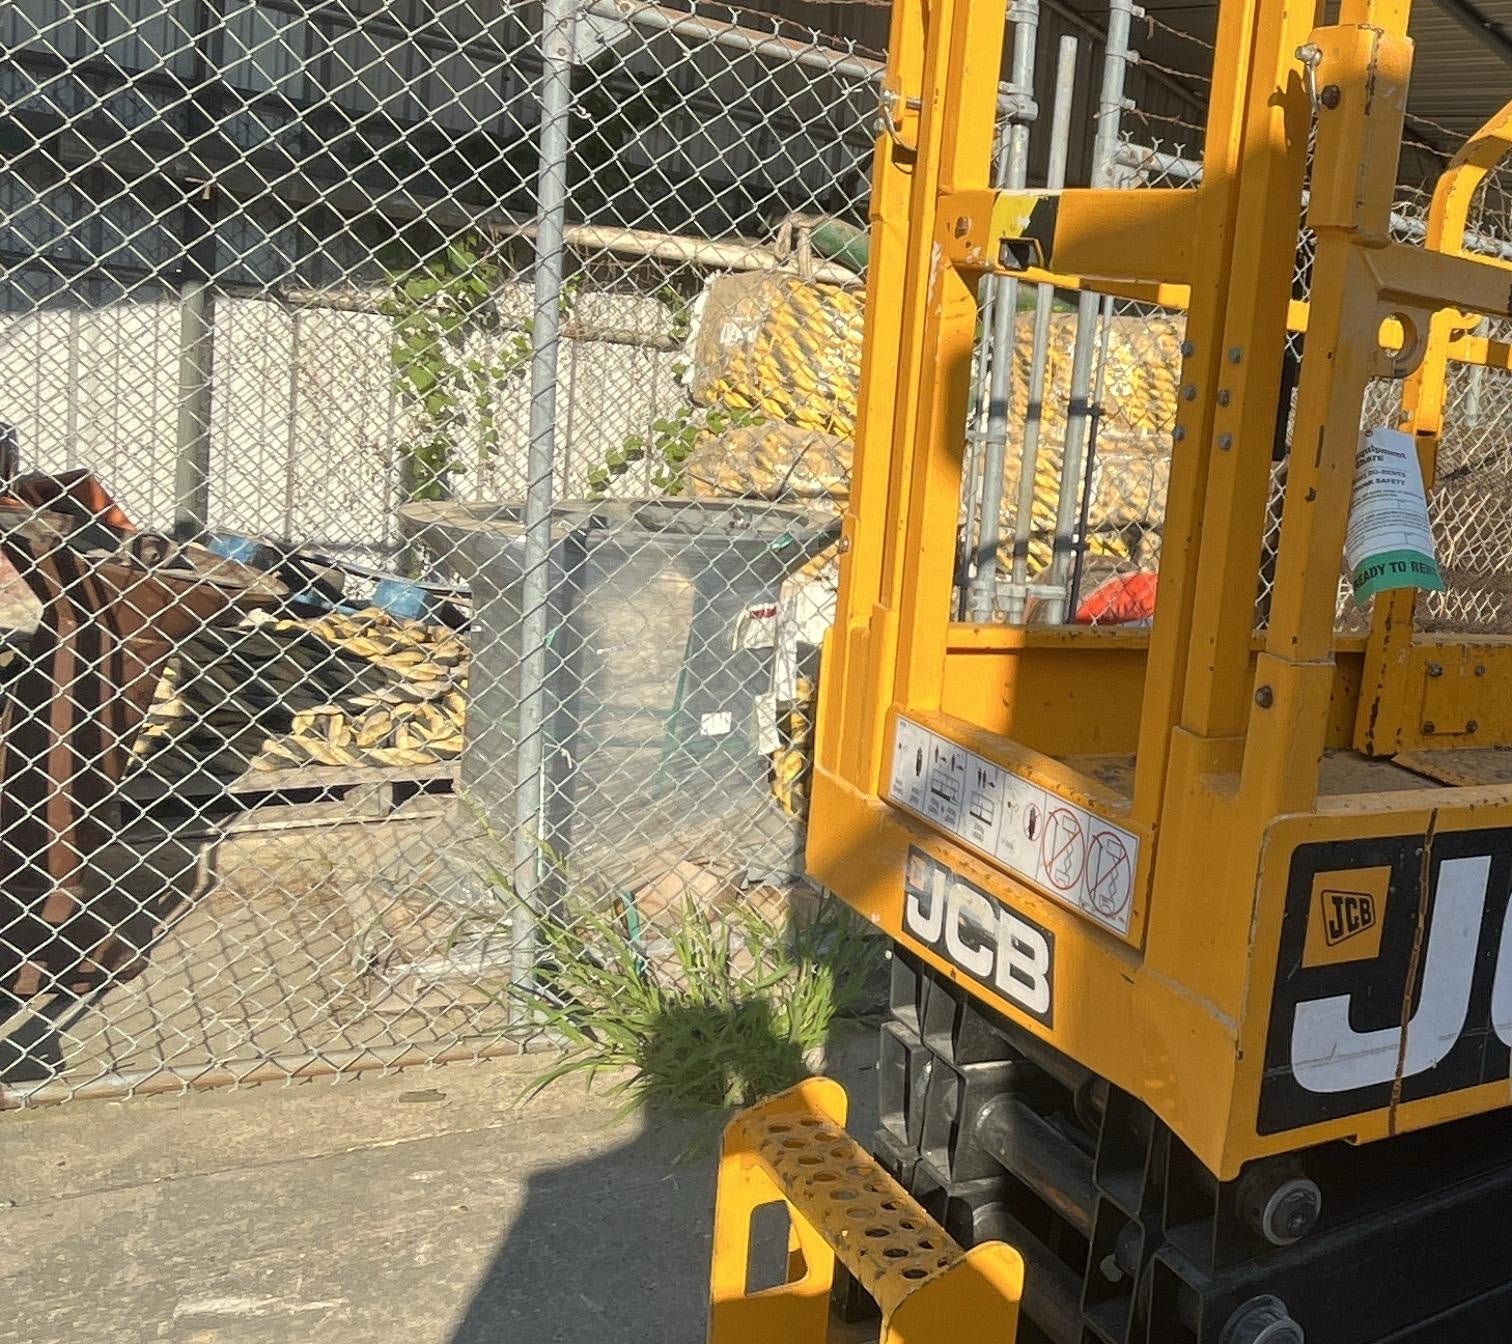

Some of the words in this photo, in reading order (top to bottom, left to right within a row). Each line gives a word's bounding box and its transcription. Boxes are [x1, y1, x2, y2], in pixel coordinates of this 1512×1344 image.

[1388, 560, 1407, 574] TO
[1328, 895, 1373, 939] JCB
[906, 868, 1051, 1014] JCB
